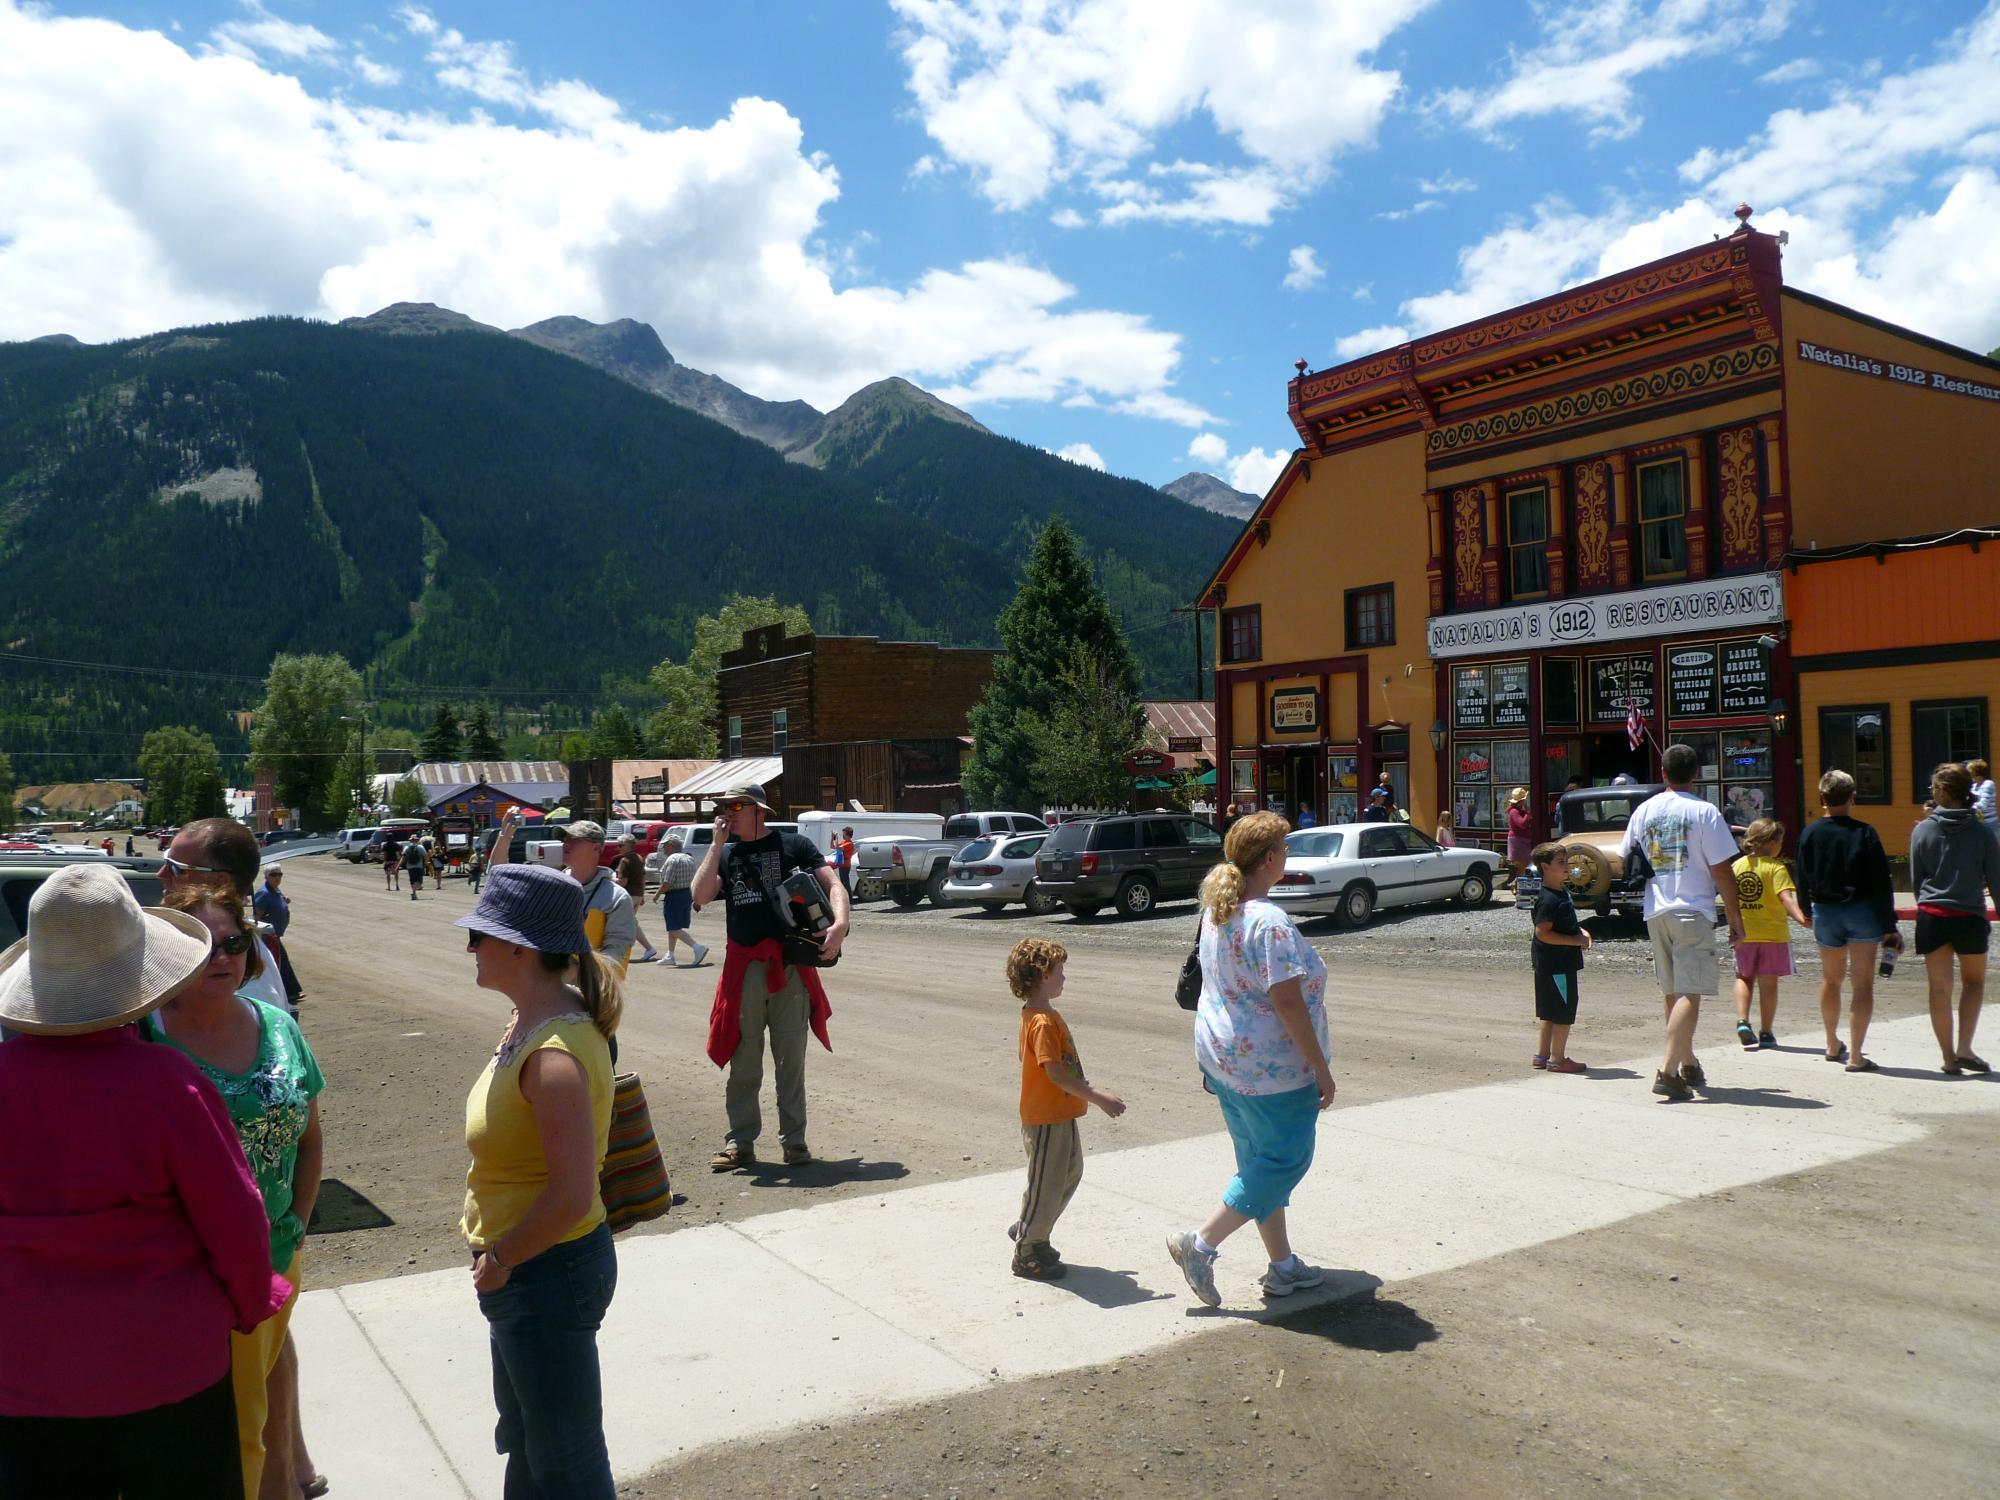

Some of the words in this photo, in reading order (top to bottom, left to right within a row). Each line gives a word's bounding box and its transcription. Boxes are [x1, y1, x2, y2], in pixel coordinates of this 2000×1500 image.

[1800, 342, 1882, 375] Natalia's
[1888, 363, 1926, 385] 1912
[1433, 611, 1538, 646] NATALIA'S
[1556, 609, 1589, 633] 1912
[1609, 588, 1771, 626] RESTAURANT
[1728, 648, 1758, 659] LARGE
[1676, 654, 1708, 663] SERVING
[1726, 660, 1761, 671] GROUPS
[1671, 668, 1714, 678] AMERICAN
[1722, 672, 1766, 684] WELCOME
[1459, 679, 1485, 688] INDOOR
[1674, 679, 1711, 689] MEXICAN
[1676, 690, 1710, 700] ITALIAN
[1457, 697, 1488, 706] OUTDOOR
[1724, 697, 1745, 707] FULL
[1748, 696, 1766, 705] BAR
[1462, 707, 1482, 715] PATIO
[1681, 703, 1706, 711] FOODS
[1500, 708, 1522, 716] FRESH
[1598, 710, 1629, 718] WELCOM
[1460, 716, 1485, 724] DINING
[732, 891, 762, 900] FOOTBALL
[734, 897, 763, 906] PLAYOFFS
